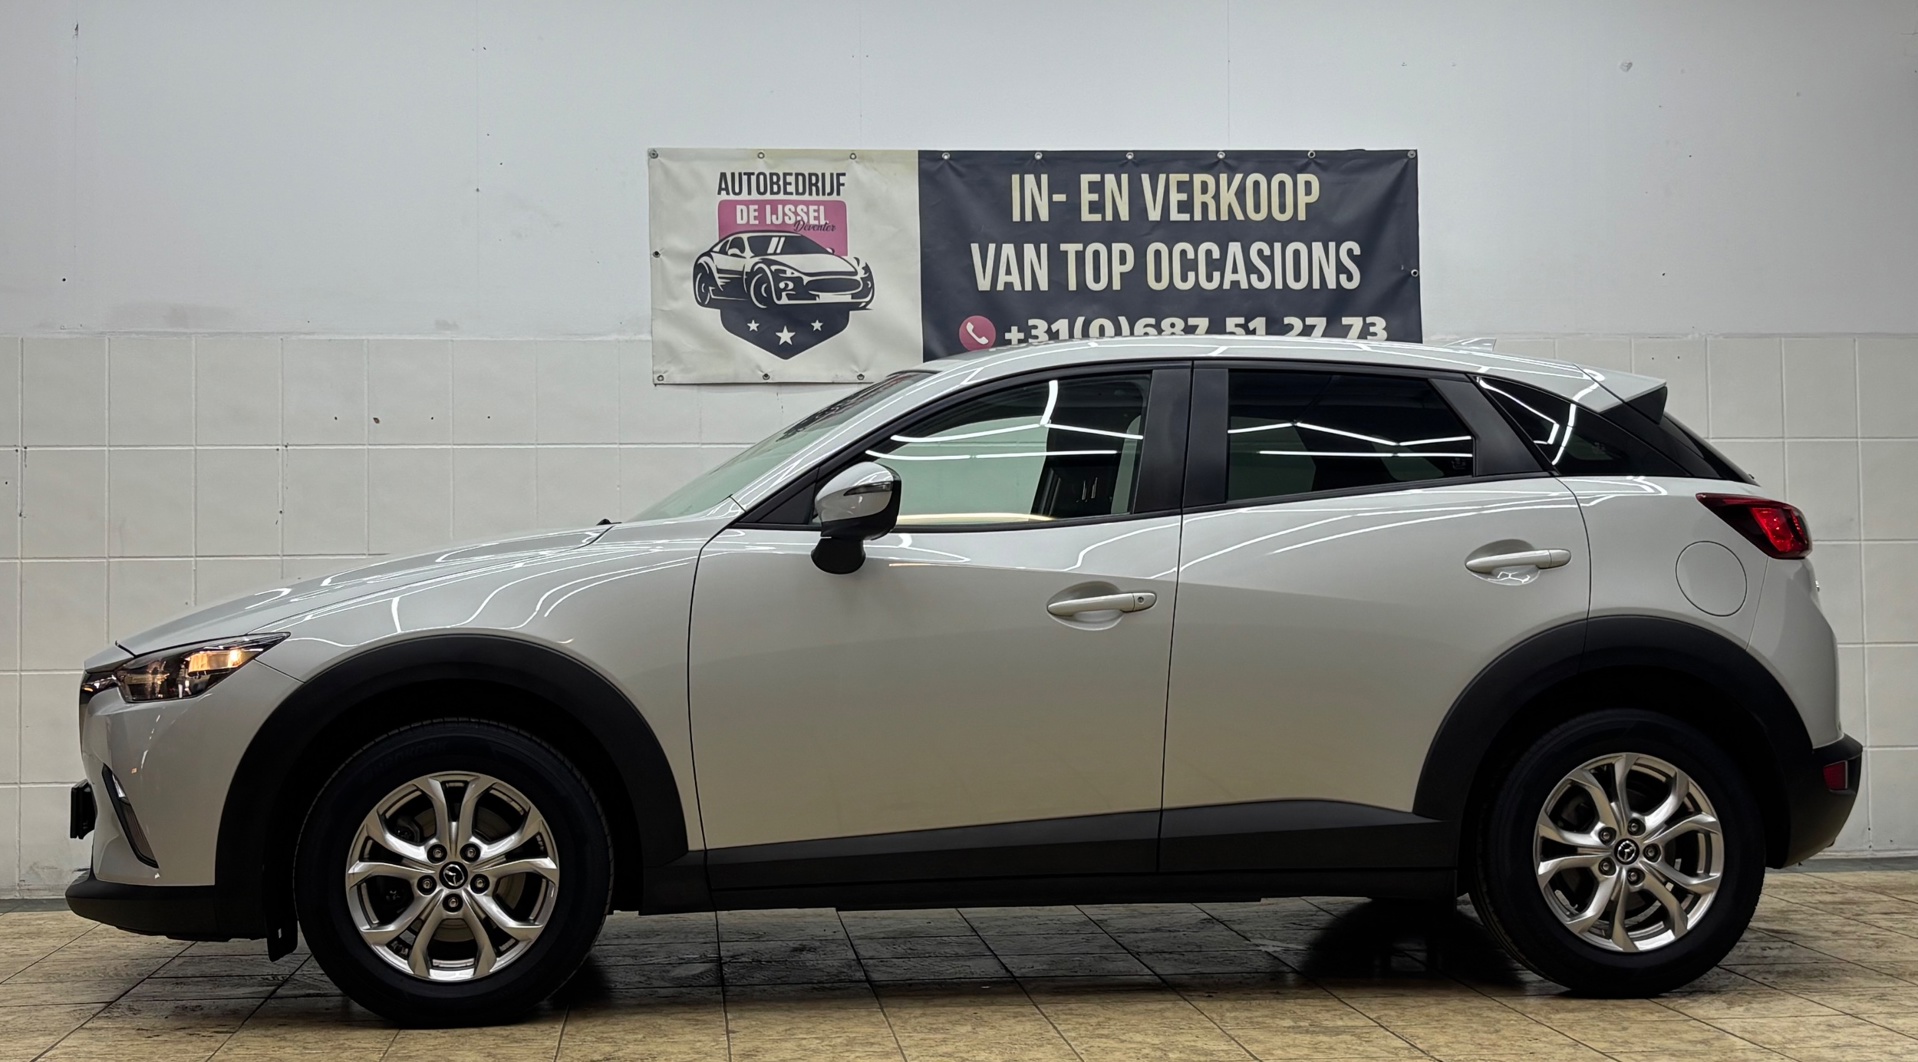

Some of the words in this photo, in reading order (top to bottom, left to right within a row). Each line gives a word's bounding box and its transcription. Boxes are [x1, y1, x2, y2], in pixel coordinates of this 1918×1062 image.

[717, 171, 846, 196] AUTOBEDRIJF
[1011, 174, 1067, 222] IN-
[1080, 174, 1130, 222] EN
[1141, 173, 1320, 222] VERKOOP
[736, 204, 759, 225] DE
[765, 204, 829, 225] IJSSEL
[793, 219, 836, 232] Deventer
[970, 243, 1048, 291] VAN
[1059, 242, 1135, 291] TOP
[1146, 241, 1361, 291] OCCASIONS
[1225, 317, 1266, 335] 51
[1283, 316, 1327, 338] 27
[1341, 316, 1388, 341] 73
